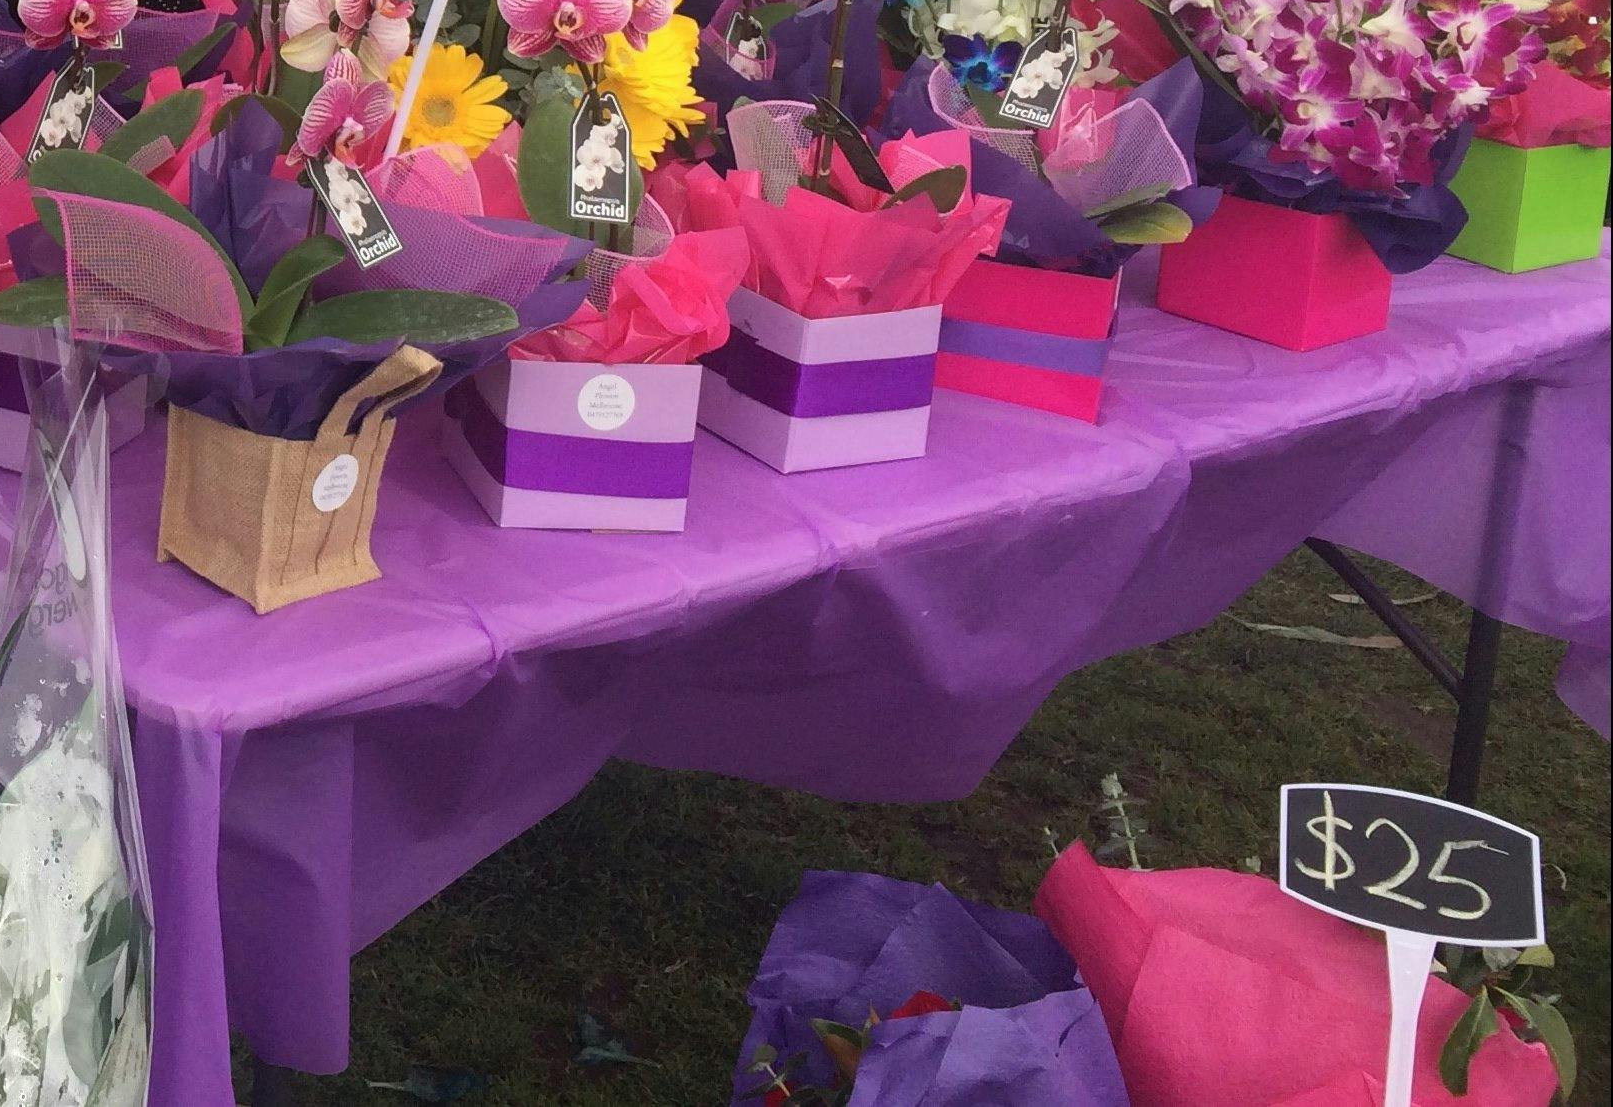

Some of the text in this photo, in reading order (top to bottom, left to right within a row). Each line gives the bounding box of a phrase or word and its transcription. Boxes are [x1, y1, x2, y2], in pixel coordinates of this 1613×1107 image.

[1004, 103, 1050, 124] Orchid
[575, 200, 625, 218] Orchid
[359, 233, 398, 261] Orchid
[1294, 790, 1510, 920] $25
